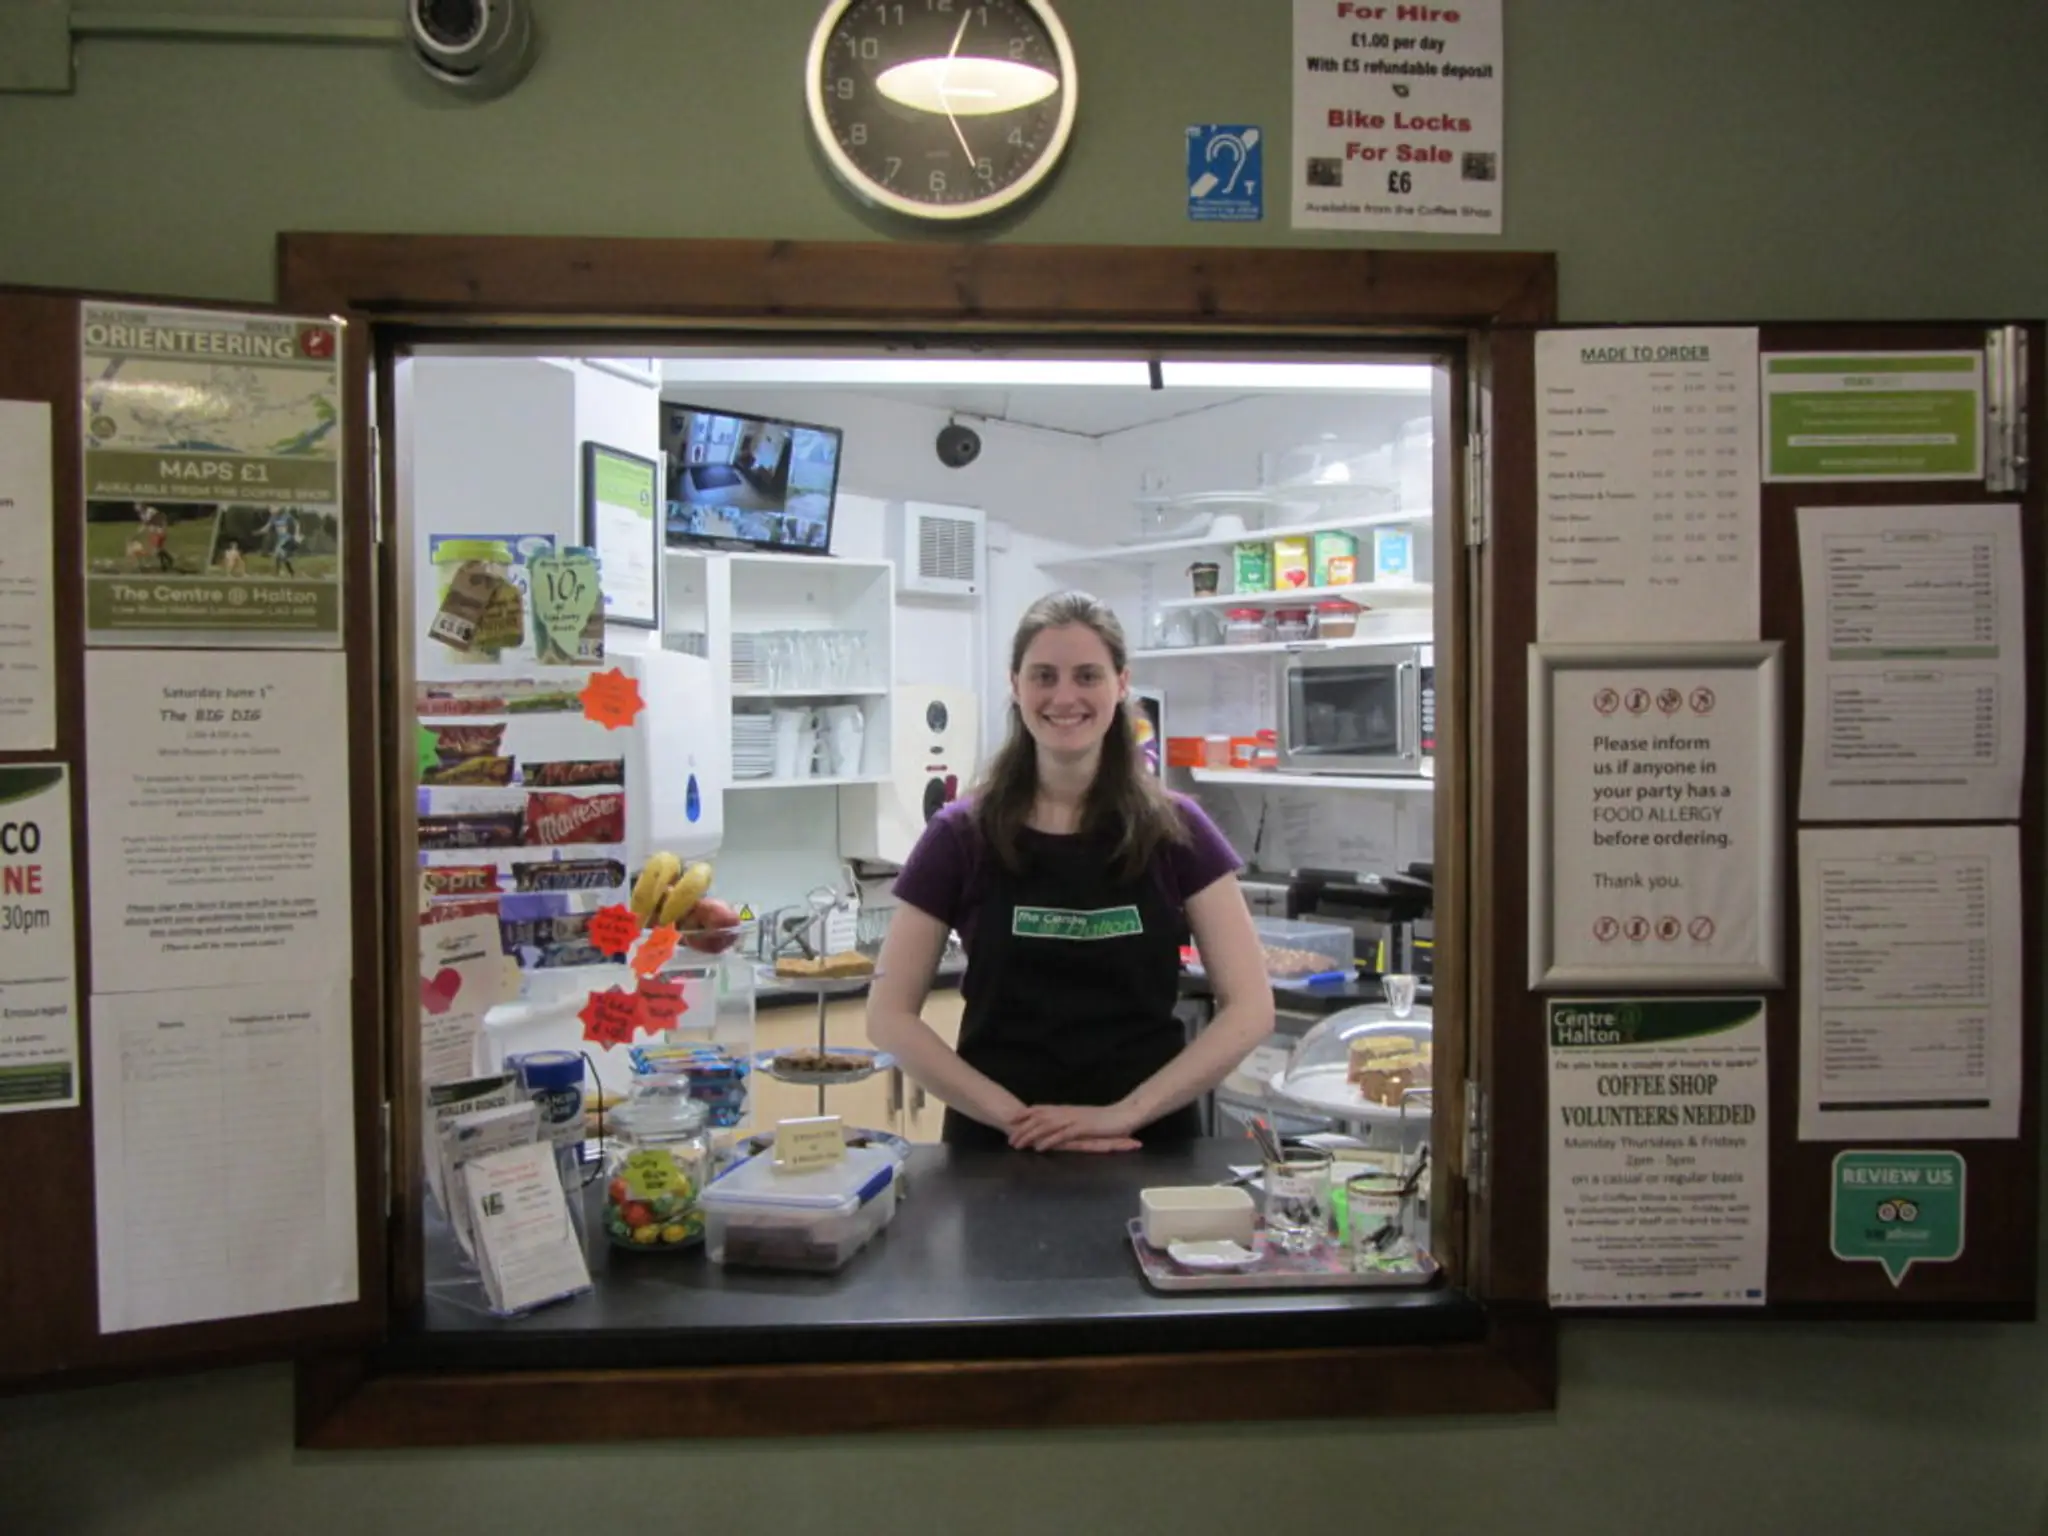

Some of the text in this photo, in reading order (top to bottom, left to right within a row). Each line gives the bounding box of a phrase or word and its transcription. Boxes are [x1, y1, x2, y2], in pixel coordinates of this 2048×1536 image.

[876, 6, 904, 26] 11
[977, 6, 988, 28] 1
[1336, 1, 1461, 23] For Hire
[846, 38, 879, 60] 10
[1351, 31, 1447, 54] £1.00 per day
[1306, 55, 1494, 81] With £5 refundable deposit
[837, 78, 855, 100] 9
[1327, 108, 1472, 133] Bike Locks
[851, 123, 868, 145] 8
[1007, 126, 1023, 148] 4
[1345, 141, 1454, 164] For Sale
[885, 157, 903, 179] 7
[977, 157, 994, 181] 5
[929, 170, 947, 192] 6
[1243, 179, 1256, 196] T
[1388, 169, 1412, 194] £6
[86, 322, 294, 358] ORIENTEERING
[1580, 345, 1710, 361] MADE TO ORDER
[160, 460, 269, 483] MAPS £1
[112, 584, 148, 602] The
[153, 585, 224, 604] Centre
[252, 586, 318, 605] Halton
[163, 686, 222, 701] Saturday
[226, 686, 256, 699] June
[159, 707, 263, 722] The BIG DIG
[1593, 735, 1710, 752] Please inform
[1593, 759, 1716, 779] us if anyone in
[1593, 782, 1731, 802] your party has a
[1593, 805, 1723, 823] FOOD ALLERGY
[1593, 830, 1734, 849] before ordering.
[1593, 872, 1683, 892] Thank you.
[1554, 1010, 1616, 1026] Centre
[1557, 1025, 1620, 1044] Halton
[1597, 1073, 1719, 1097] COFFEE SHOP
[475, 1096, 506, 1111] DISCO
[1561, 1103, 1756, 1127] VOLUNTEERS NEEDED
[1564, 1136, 1617, 1150] Monday
[1620, 1135, 1685, 1149] Thursdays
[1701, 1135, 1747, 1149] Fridays
[1625, 1154, 1655, 1168] 2pm
[1665, 1154, 1696, 1168] 5pm
[1602, 1171, 1642, 1185] casual
[1663, 1172, 1708, 1187] regular
[1711, 1170, 1744, 1184] basis
[1843, 1167, 1953, 1185] REVIEW US
